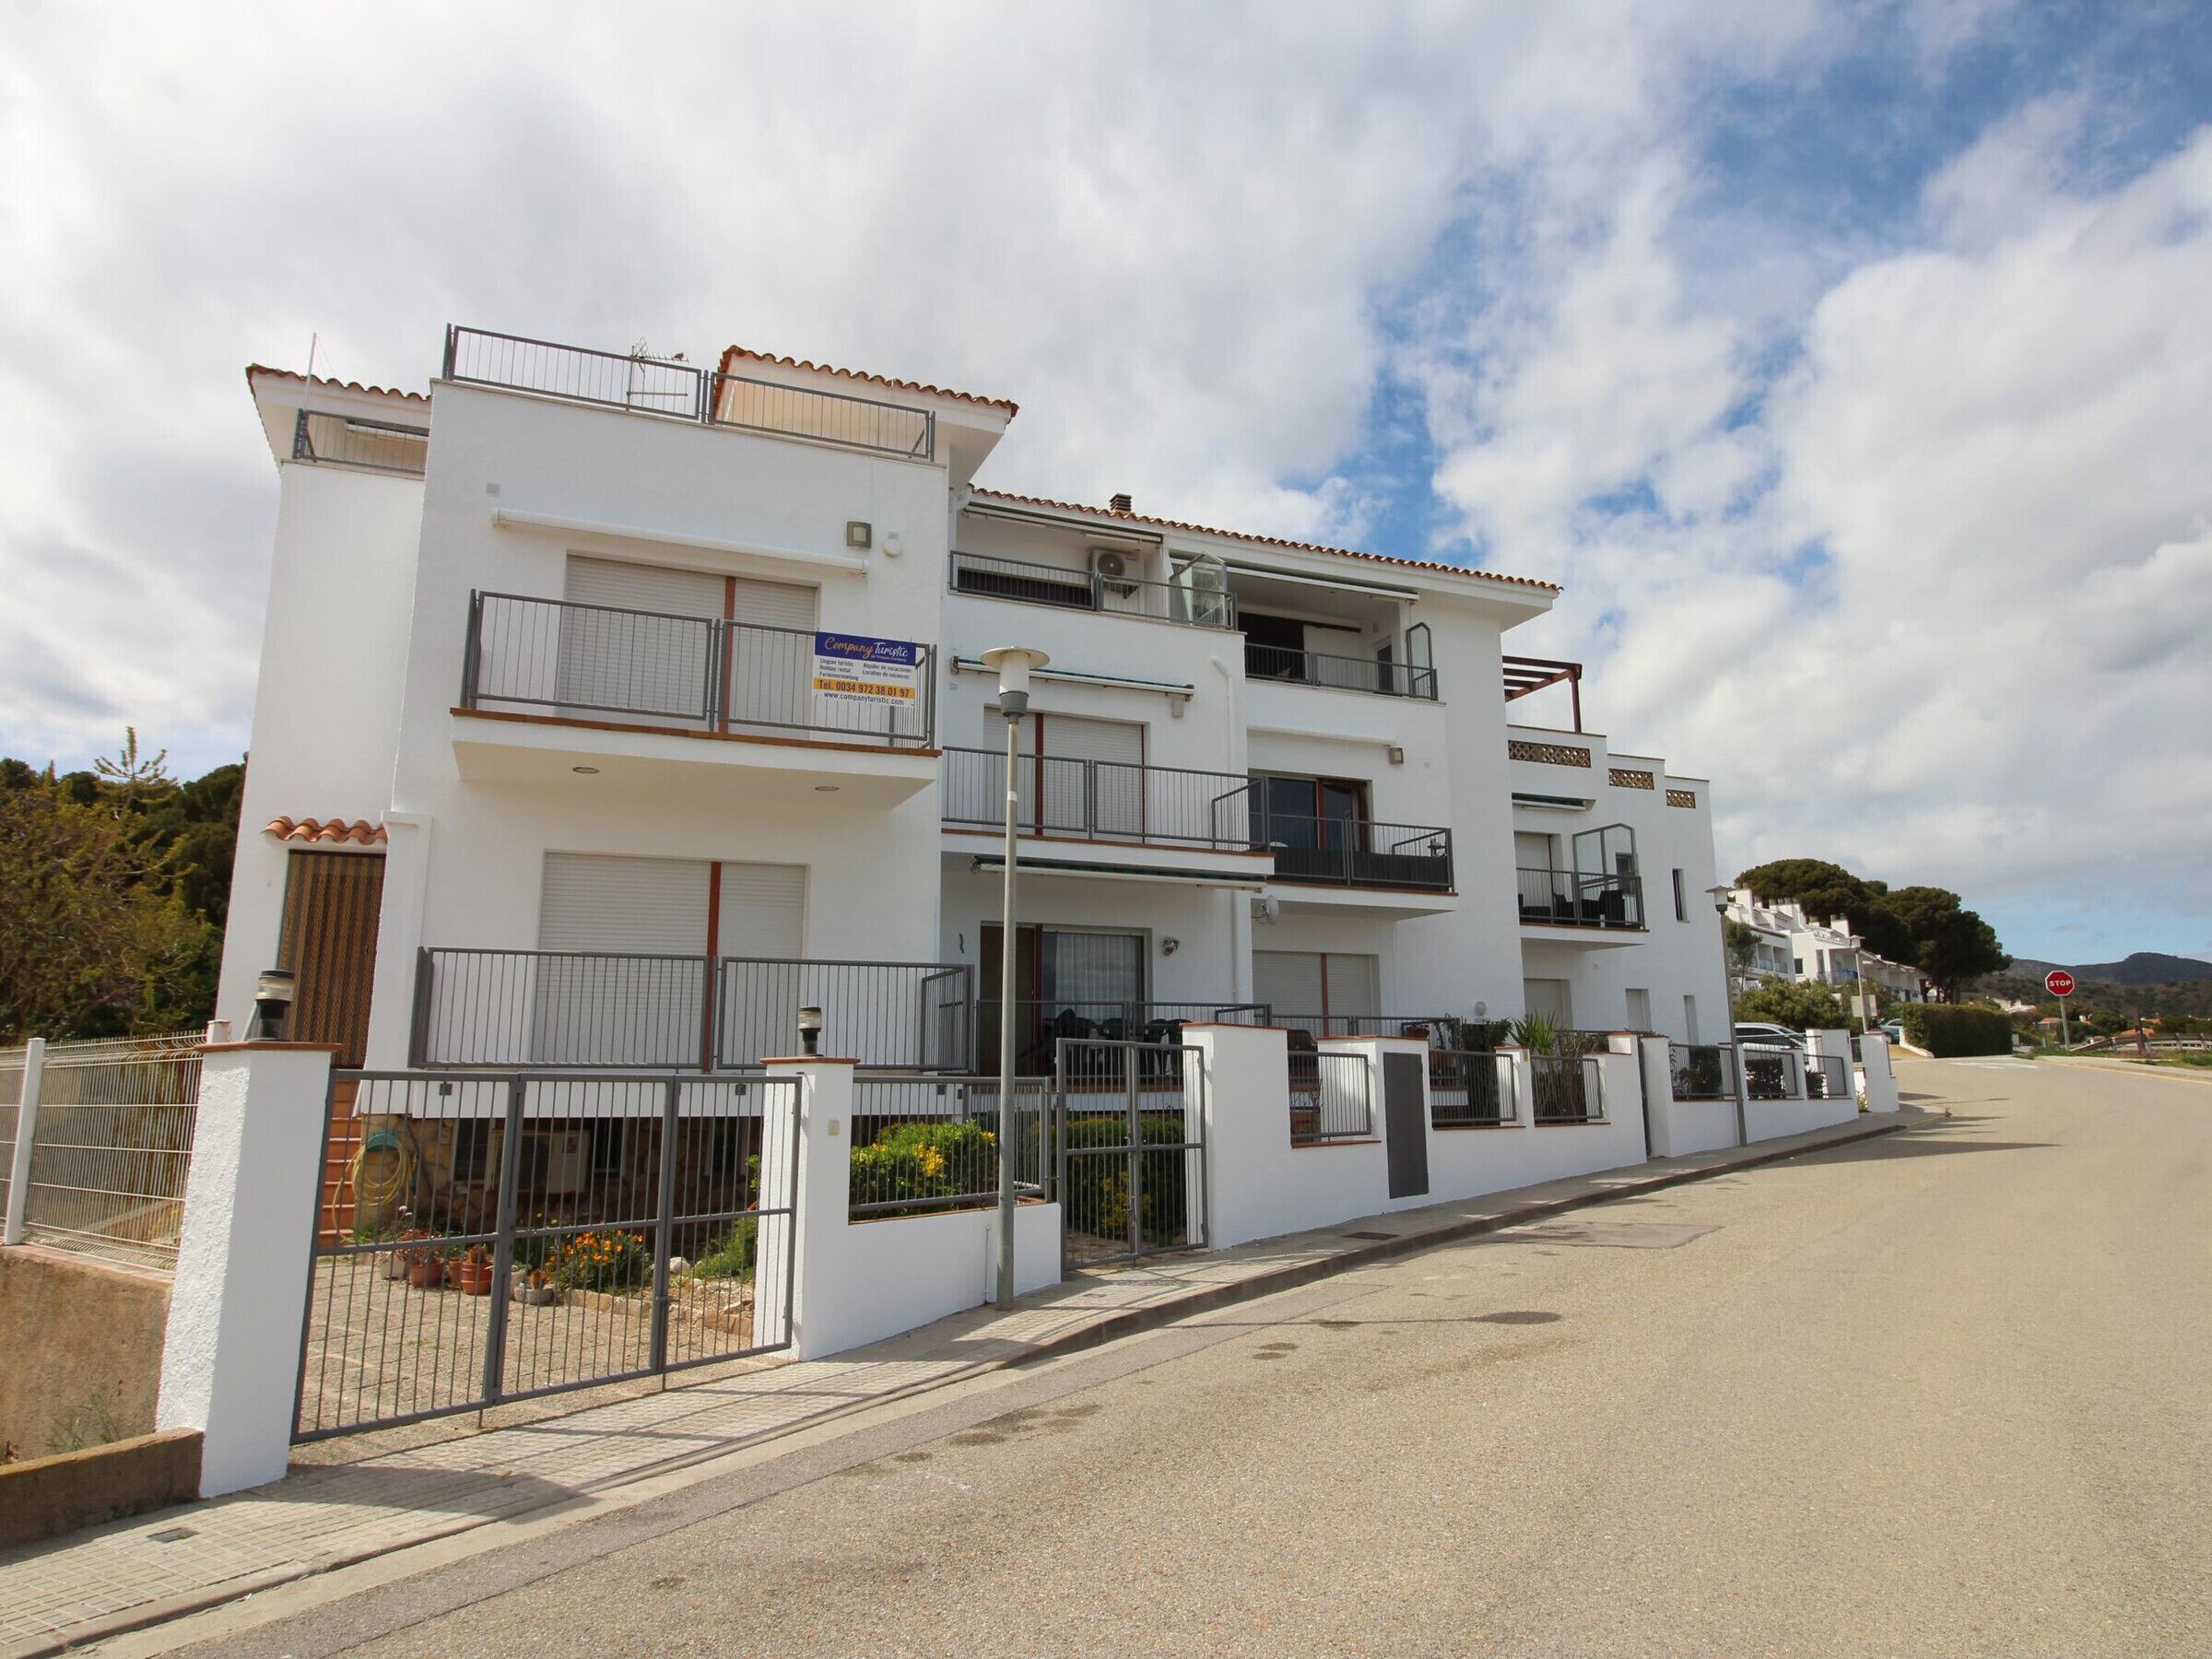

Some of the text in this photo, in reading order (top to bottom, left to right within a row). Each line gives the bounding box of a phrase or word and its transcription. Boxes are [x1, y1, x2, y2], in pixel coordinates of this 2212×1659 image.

[825, 637, 874, 659] Company
[819, 680, 910, 698] Tel. 0034 972 38 01 97
[824, 692, 904, 705] www.companyturistic.com
